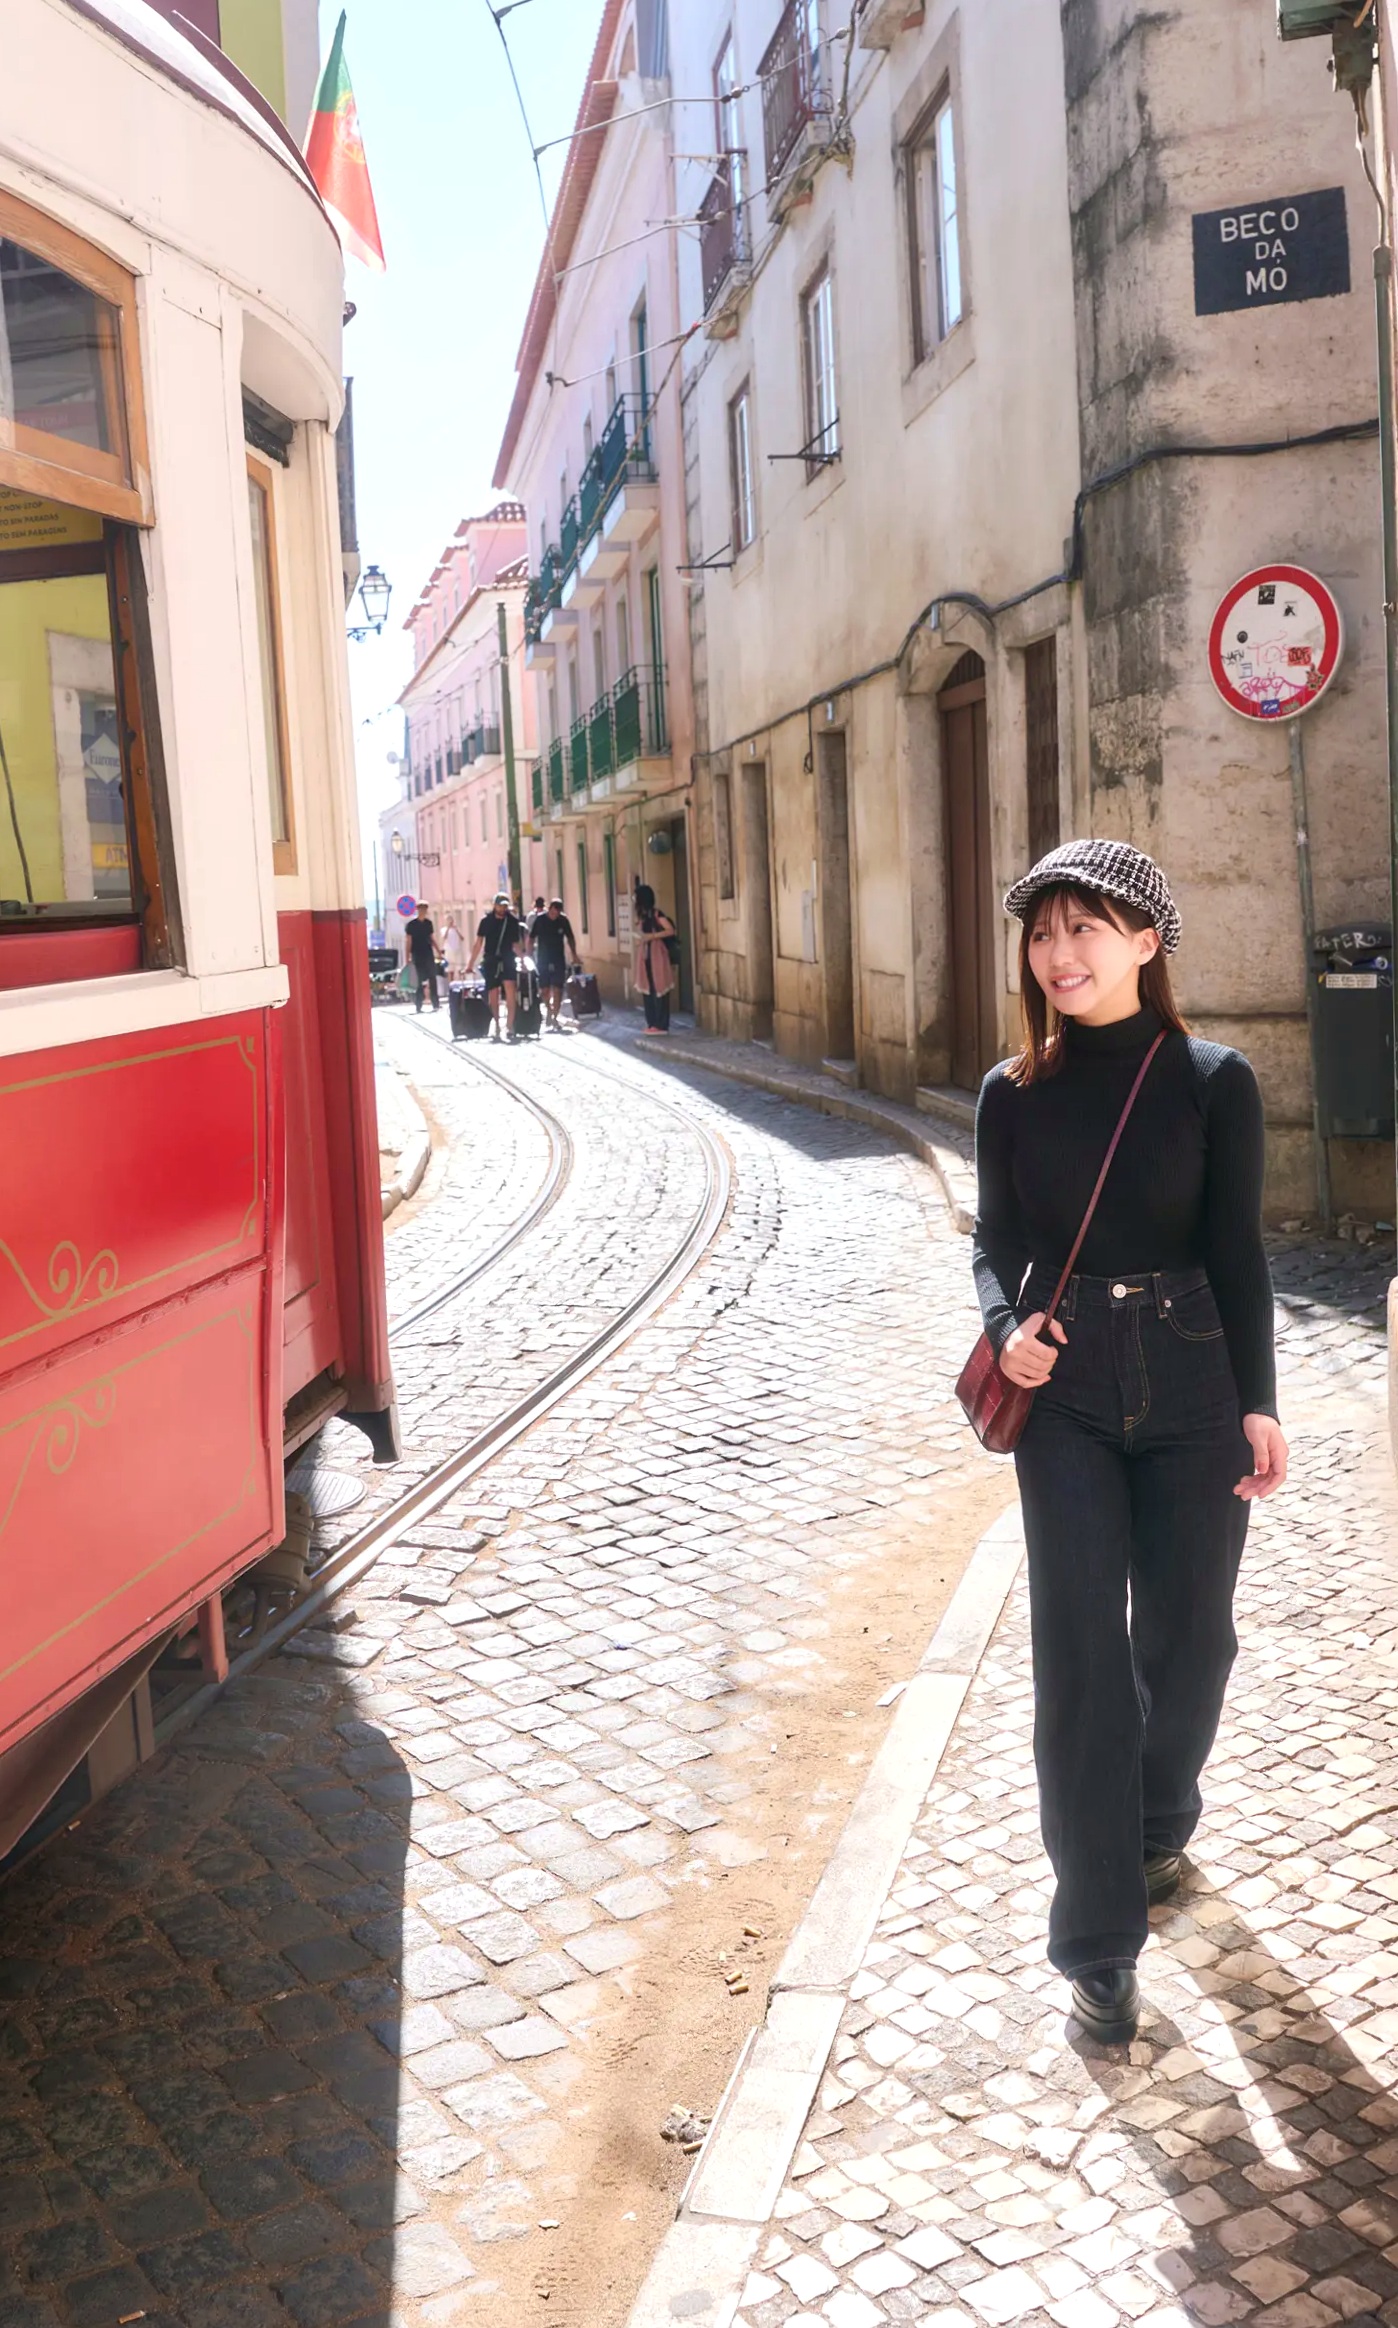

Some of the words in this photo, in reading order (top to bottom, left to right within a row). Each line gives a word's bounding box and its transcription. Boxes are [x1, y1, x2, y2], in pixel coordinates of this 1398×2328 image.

[1220, 207, 1299, 242] BECO
[1255, 238, 1287, 260] DA
[24, 512, 60, 522] PARADAS
[11, 530, 26, 538] SEM
[28, 526, 68, 536] PARAGENS
